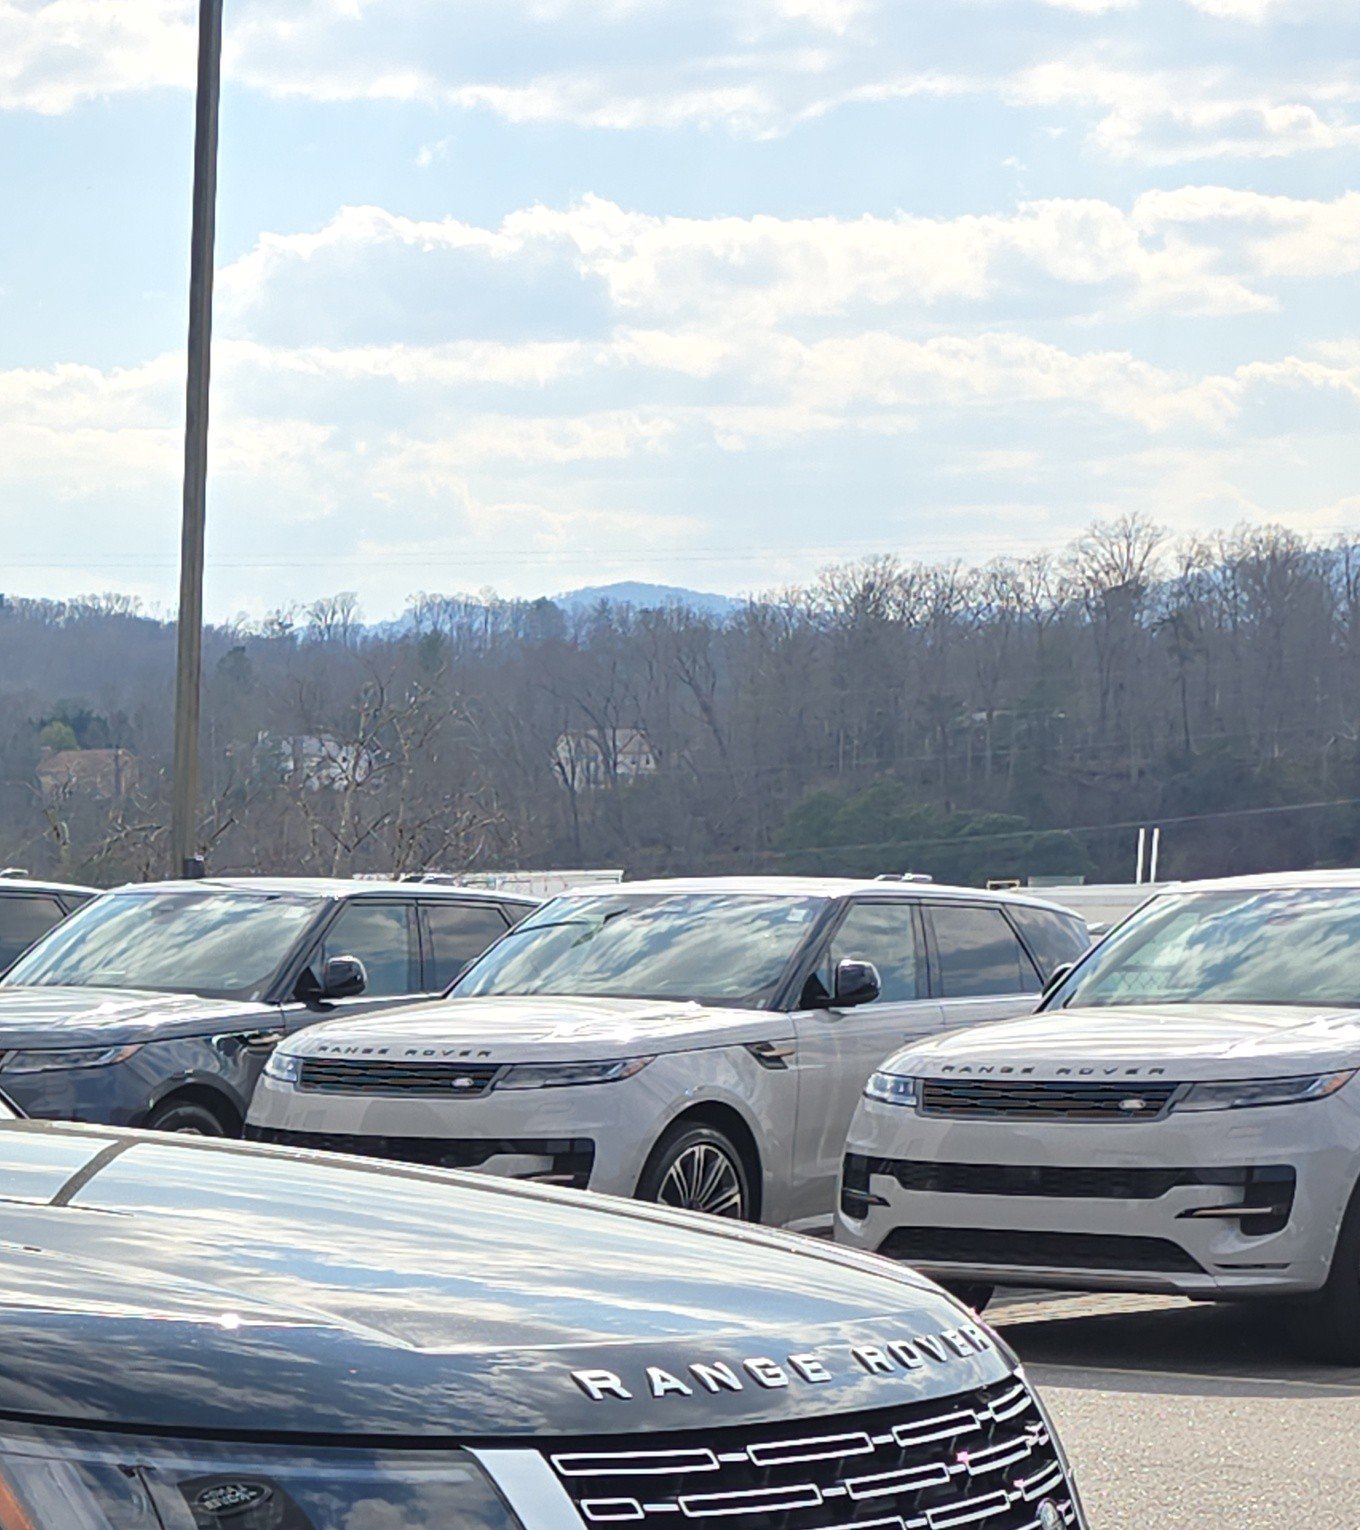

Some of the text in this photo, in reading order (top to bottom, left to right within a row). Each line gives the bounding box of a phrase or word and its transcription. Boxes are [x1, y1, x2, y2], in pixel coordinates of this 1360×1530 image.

[318, 1046, 390, 1054] RANGE
[941, 1065, 1166, 1075] RANGE ROVER
[571, 1323, 990, 1400] RANGE ROVER
